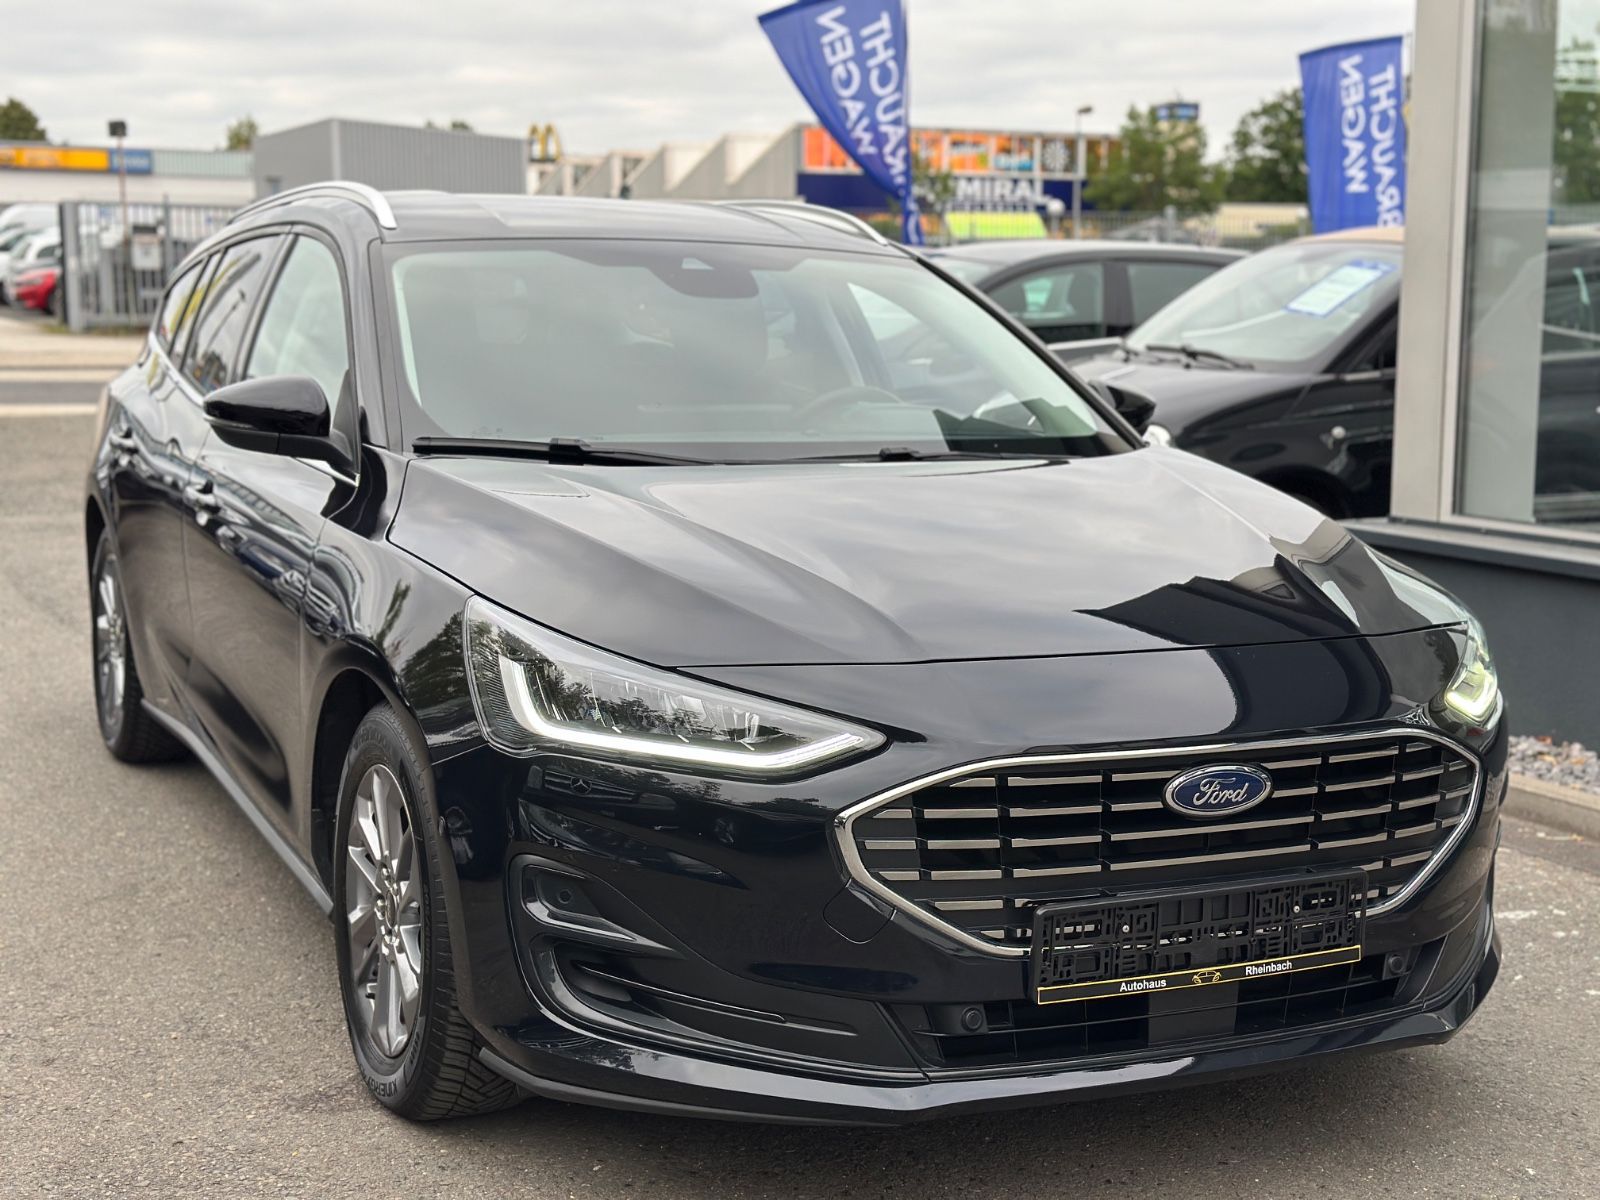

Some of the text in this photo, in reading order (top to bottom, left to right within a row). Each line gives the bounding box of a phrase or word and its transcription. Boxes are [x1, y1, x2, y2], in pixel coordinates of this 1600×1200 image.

[1193, 777, 1249, 806] Ford
[1119, 960, 1293, 993] Autohaus Rheinbach
